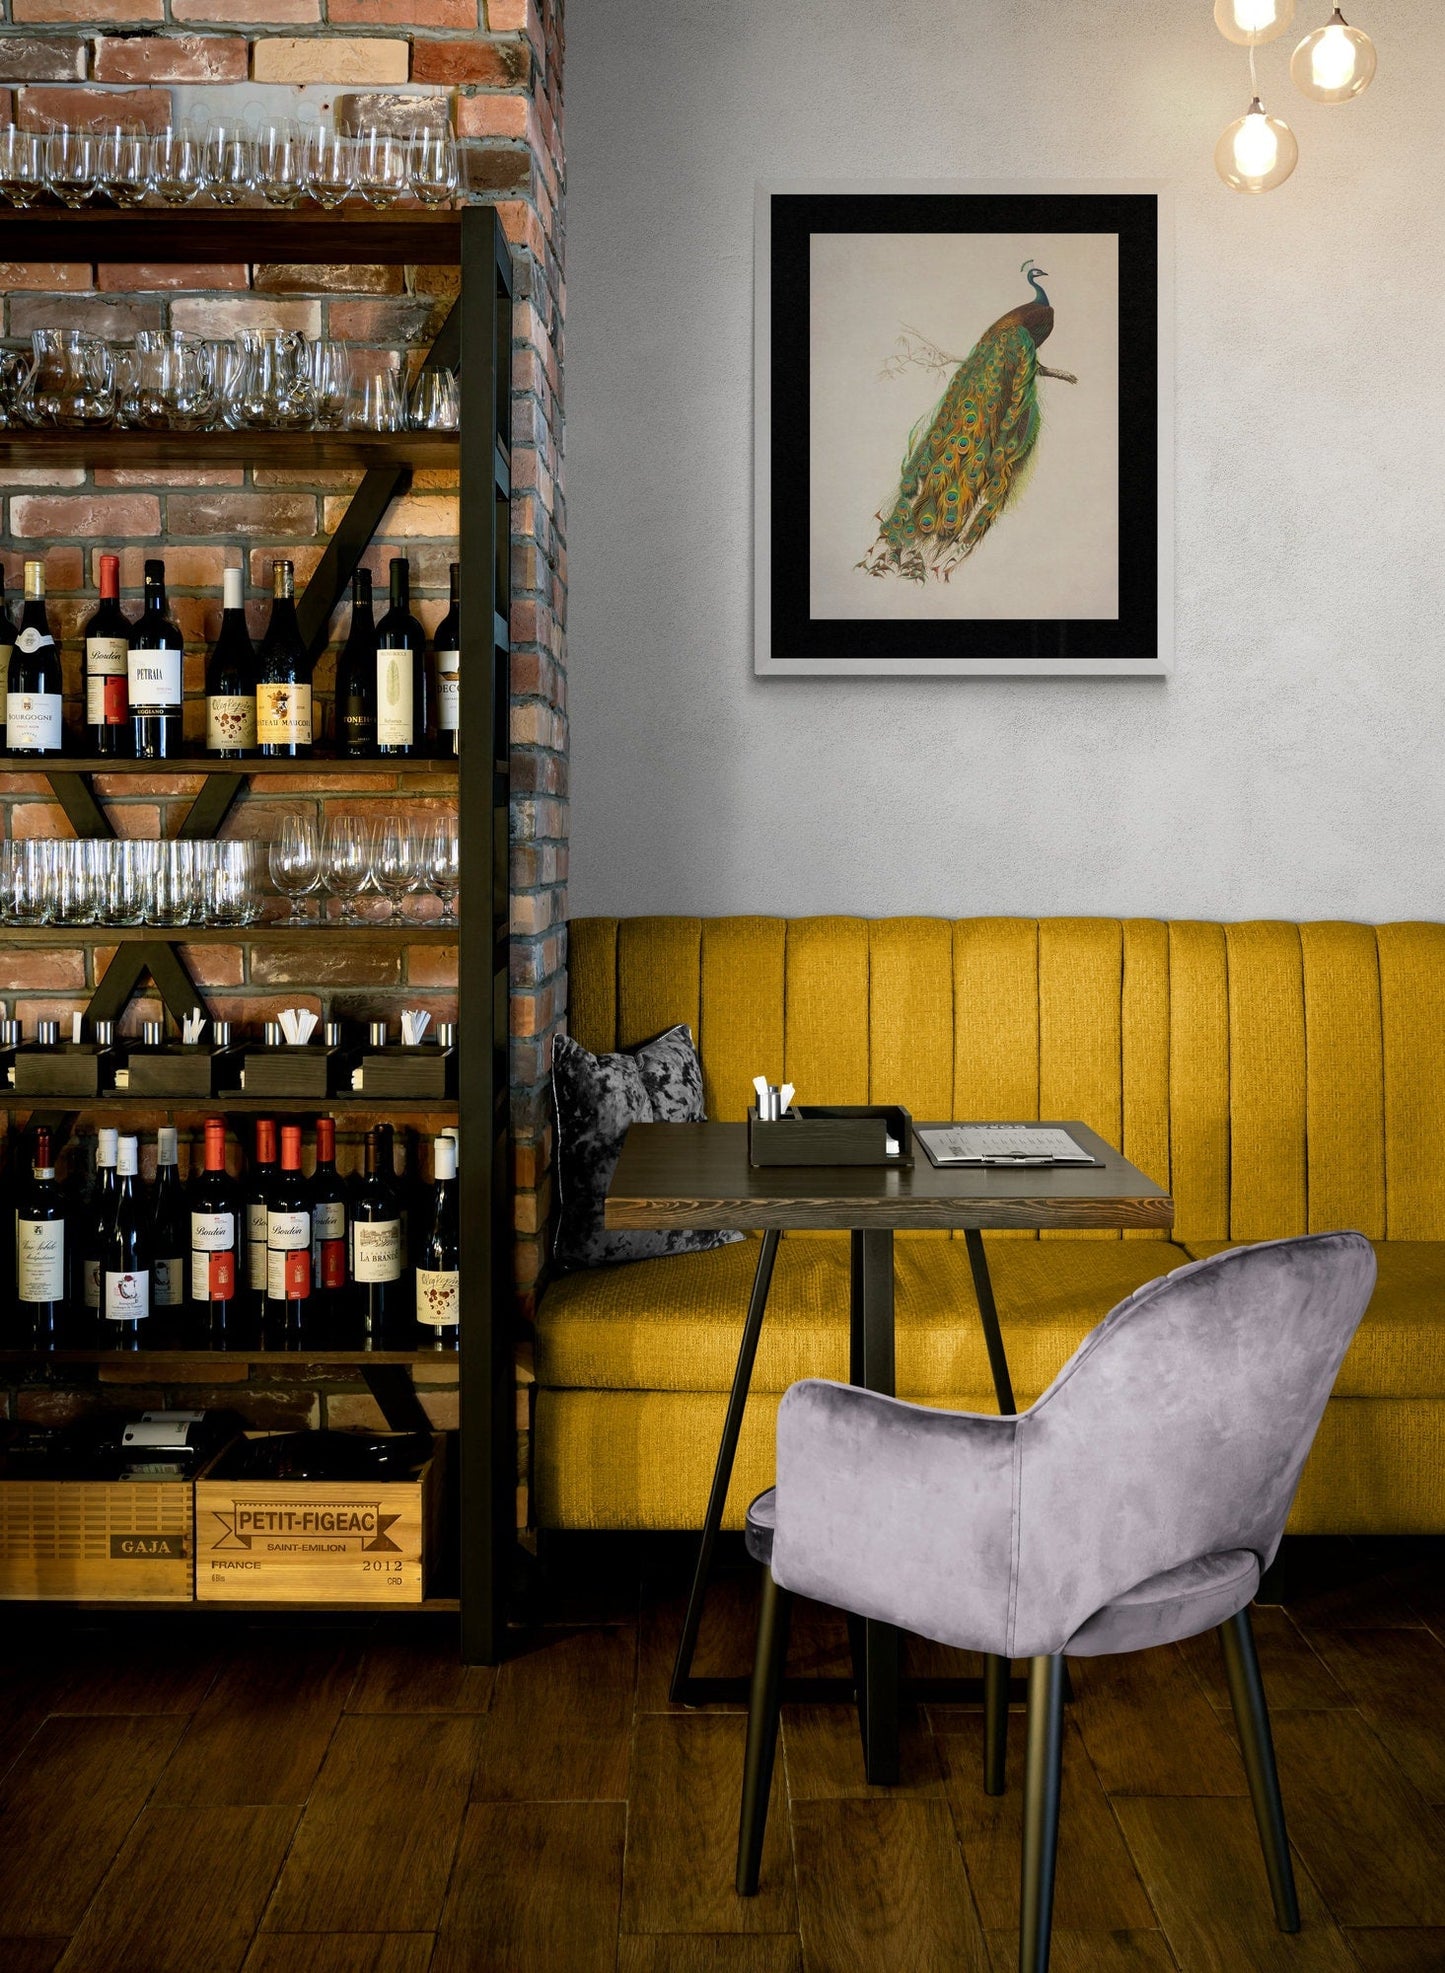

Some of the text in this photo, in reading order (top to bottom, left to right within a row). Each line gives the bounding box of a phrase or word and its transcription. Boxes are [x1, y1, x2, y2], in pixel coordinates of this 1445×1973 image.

[136, 668, 163, 681] PETRAIA
[360, 1251, 371, 1262] LA
[239, 1511, 376, 1533] PETIT-FIGEAC
[121, 1540, 172, 1554] GAJA
[267, 1543, 347, 1553] SAINT-EMILION
[211, 1560, 262, 1570] FRANCE
[362, 1560, 403, 1571] 2012
